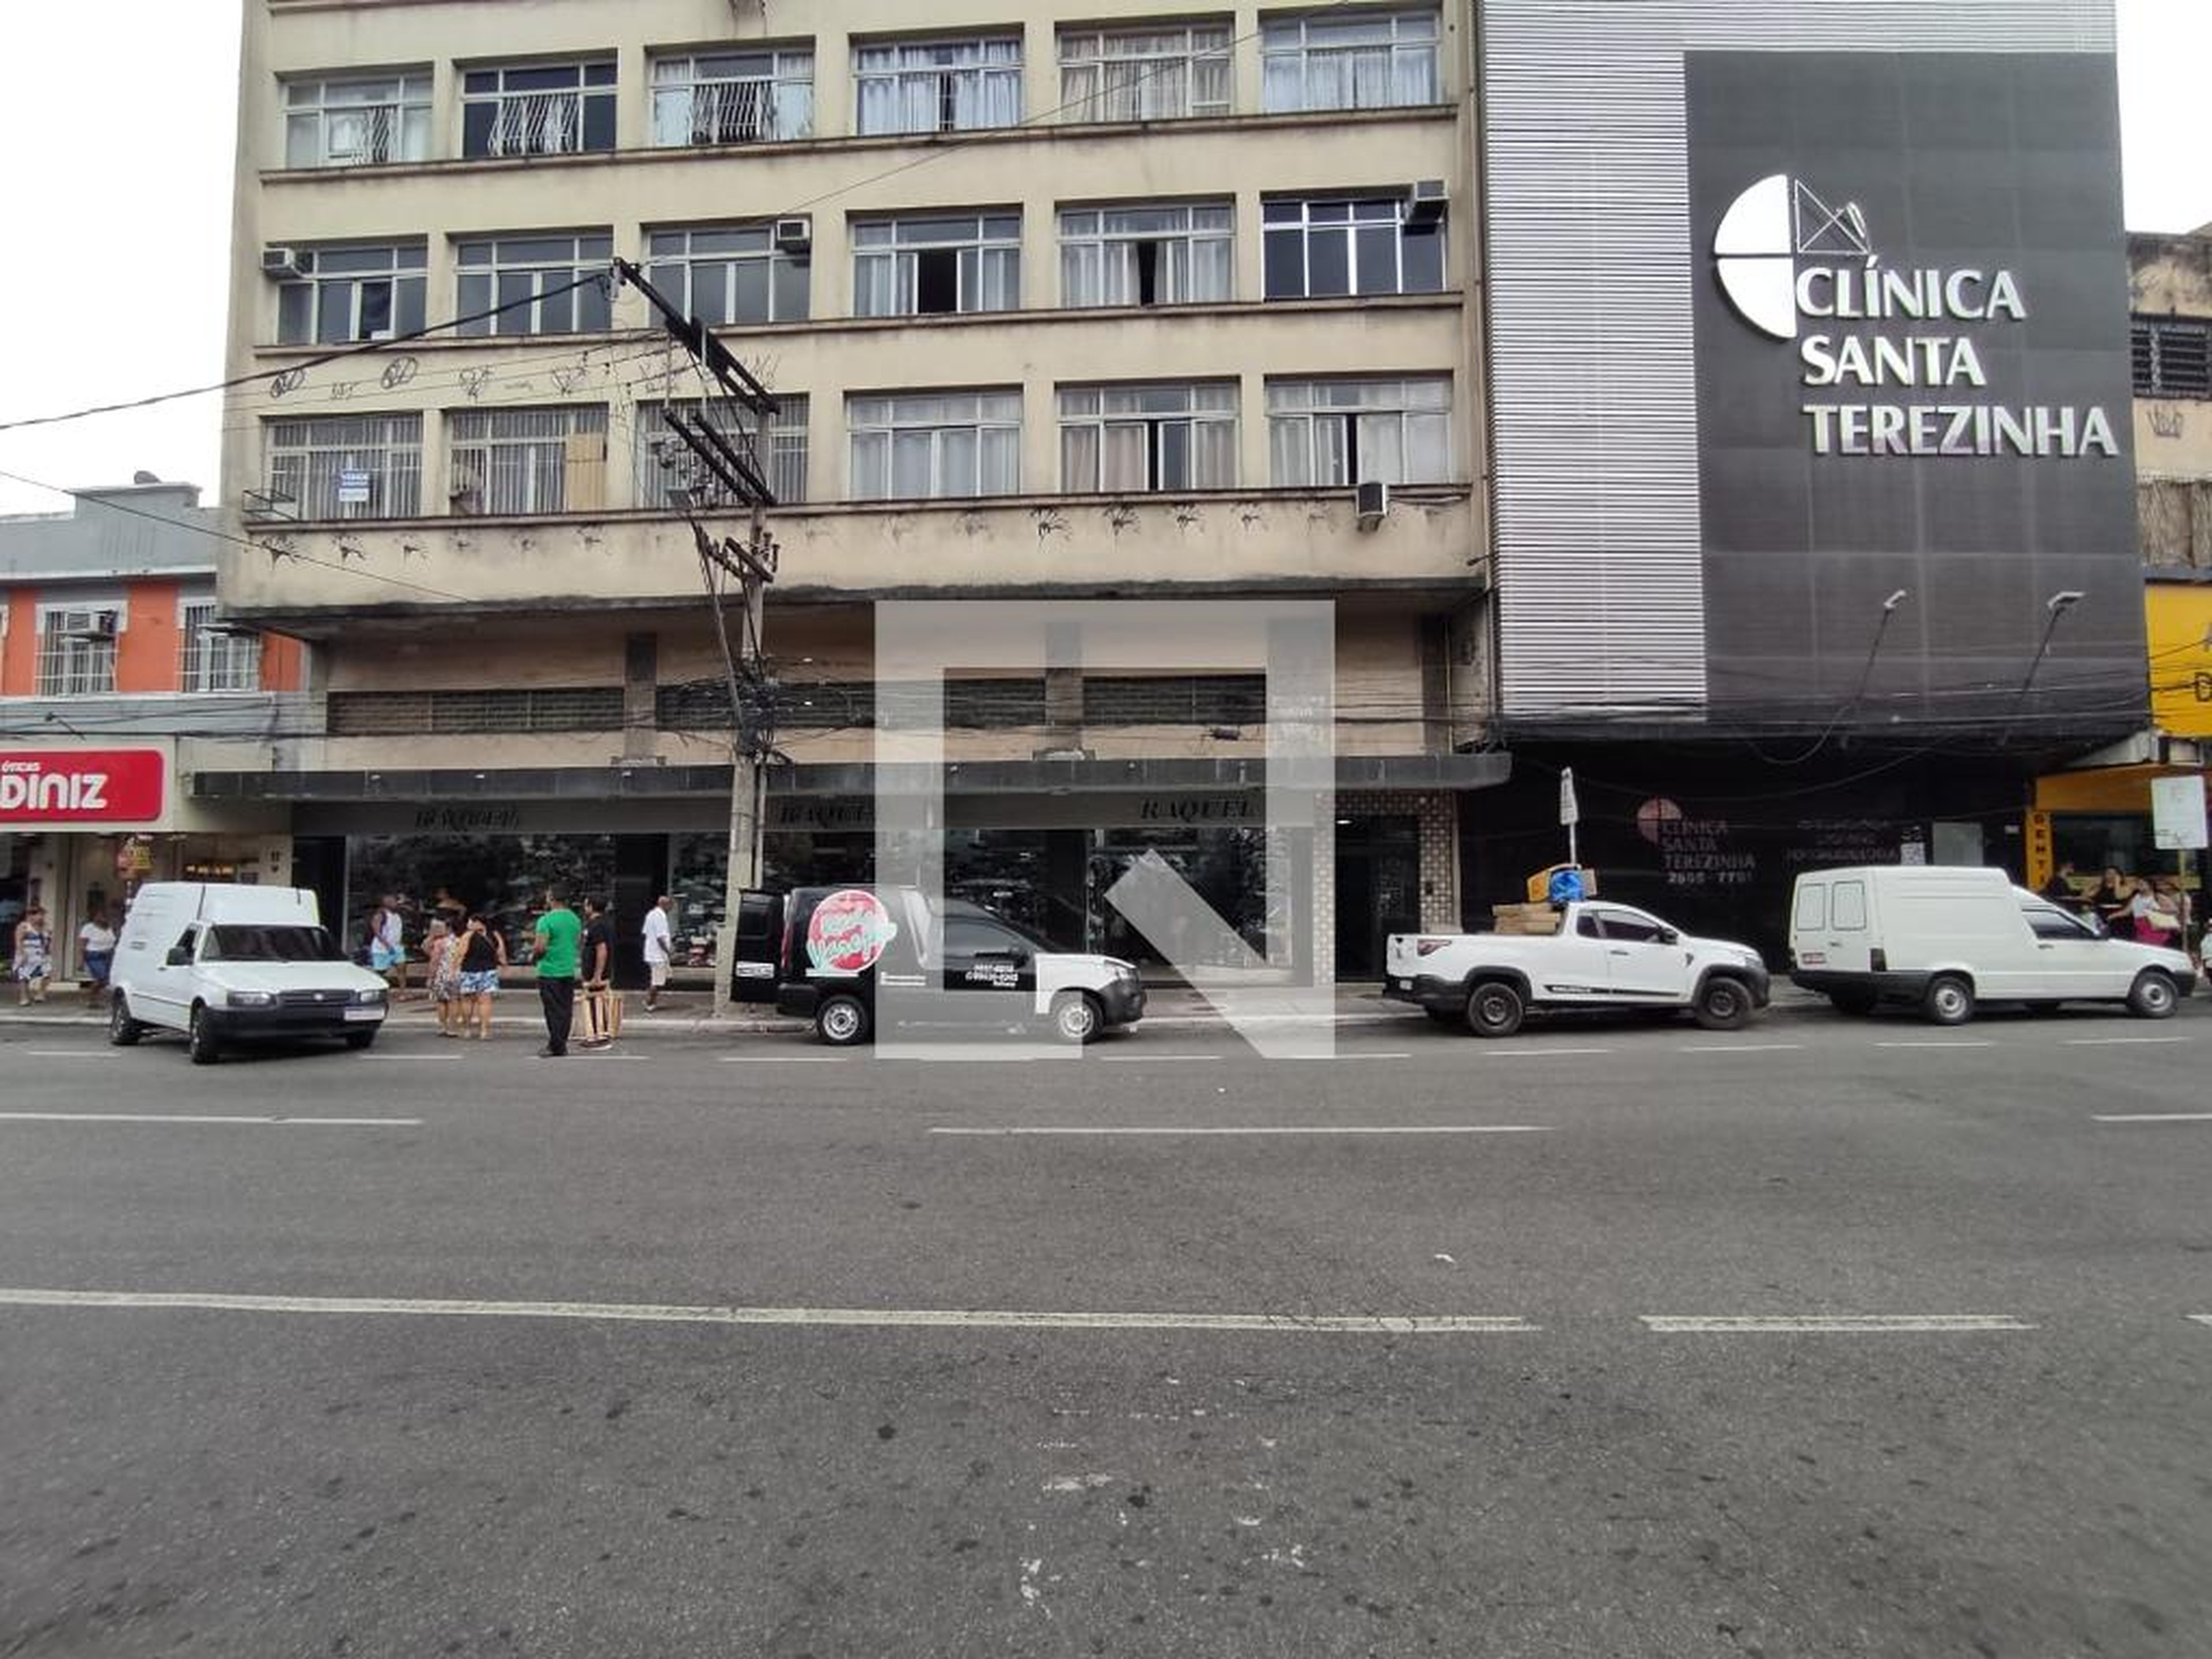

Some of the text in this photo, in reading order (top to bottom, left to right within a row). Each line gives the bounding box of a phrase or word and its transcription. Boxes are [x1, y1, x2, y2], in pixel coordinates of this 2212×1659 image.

[1796, 255, 2026, 319] CLÍNICA
[1801, 335, 1986, 385] SANTA
[1803, 405, 2119, 455] TEREZINHA
